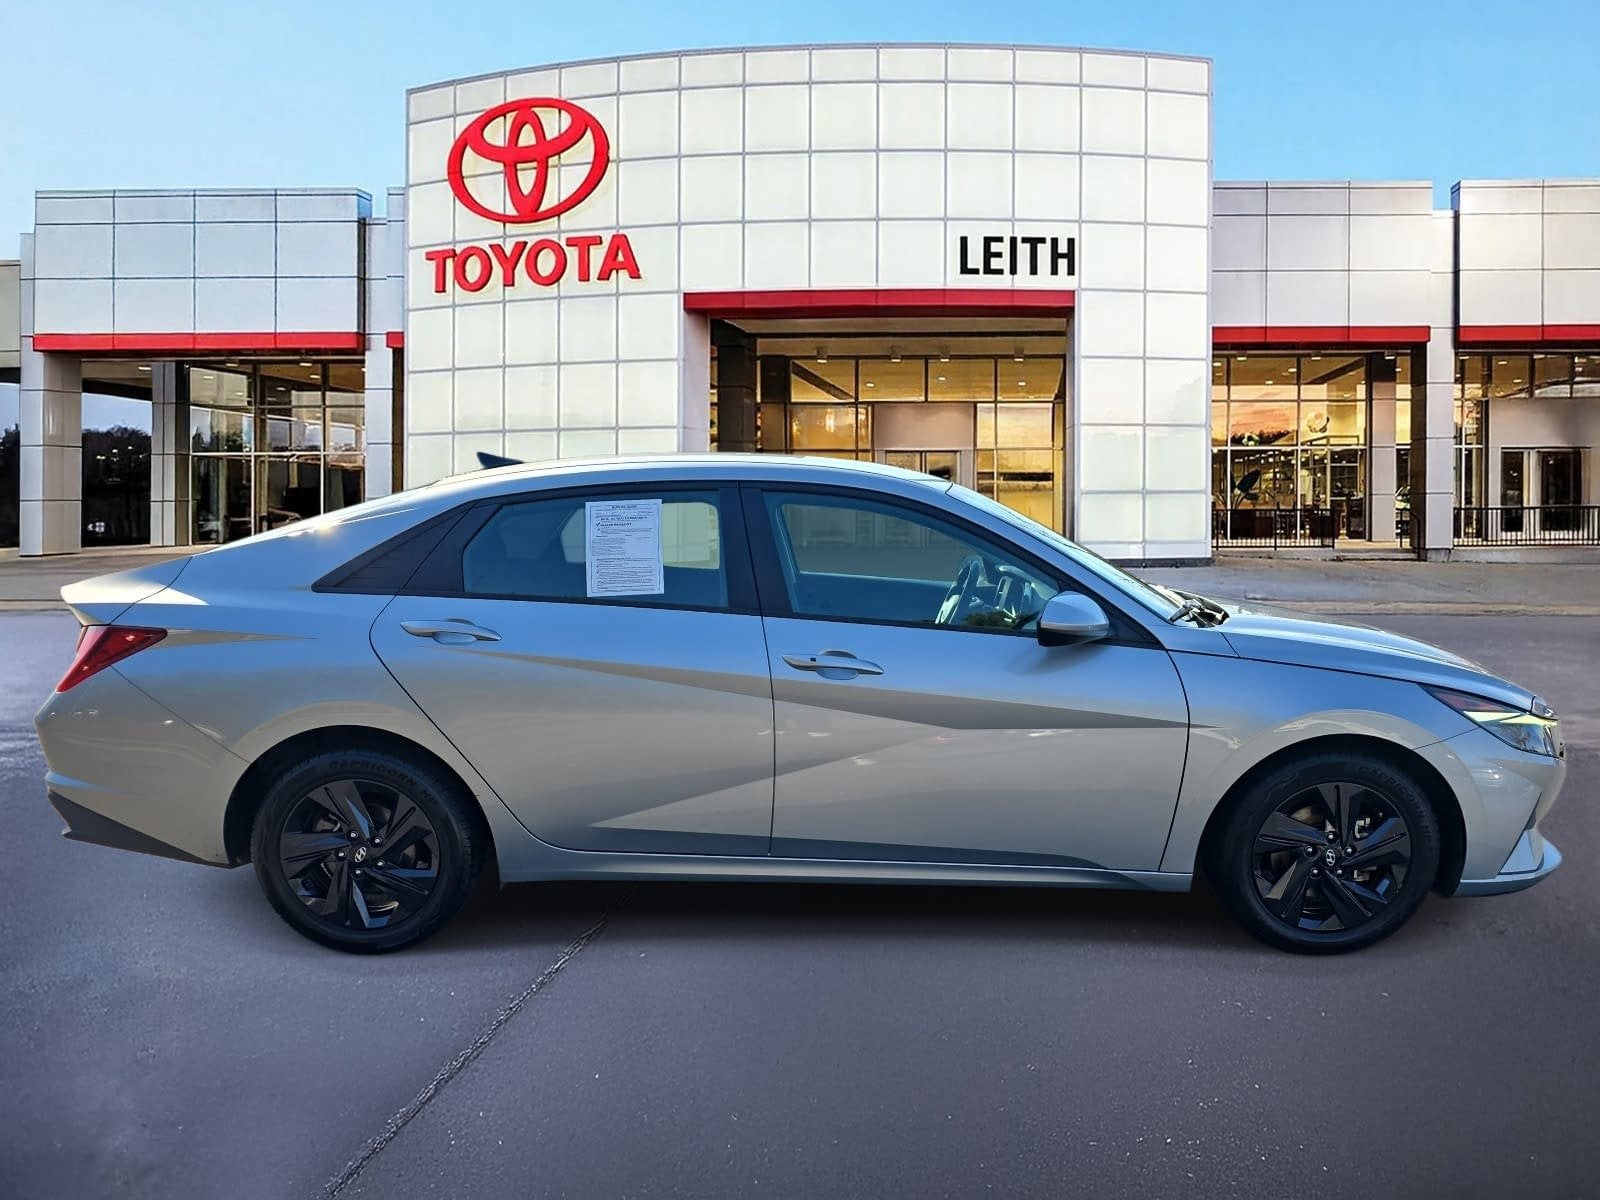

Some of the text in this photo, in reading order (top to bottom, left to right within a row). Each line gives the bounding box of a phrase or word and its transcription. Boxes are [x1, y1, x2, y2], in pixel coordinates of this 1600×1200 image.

[425, 234, 642, 293] TOYOTA
[960, 236, 1075, 276] LEITH
[329, 759, 417, 787] CAPRICORN
[1358, 766, 1430, 819] CAPRICORN
